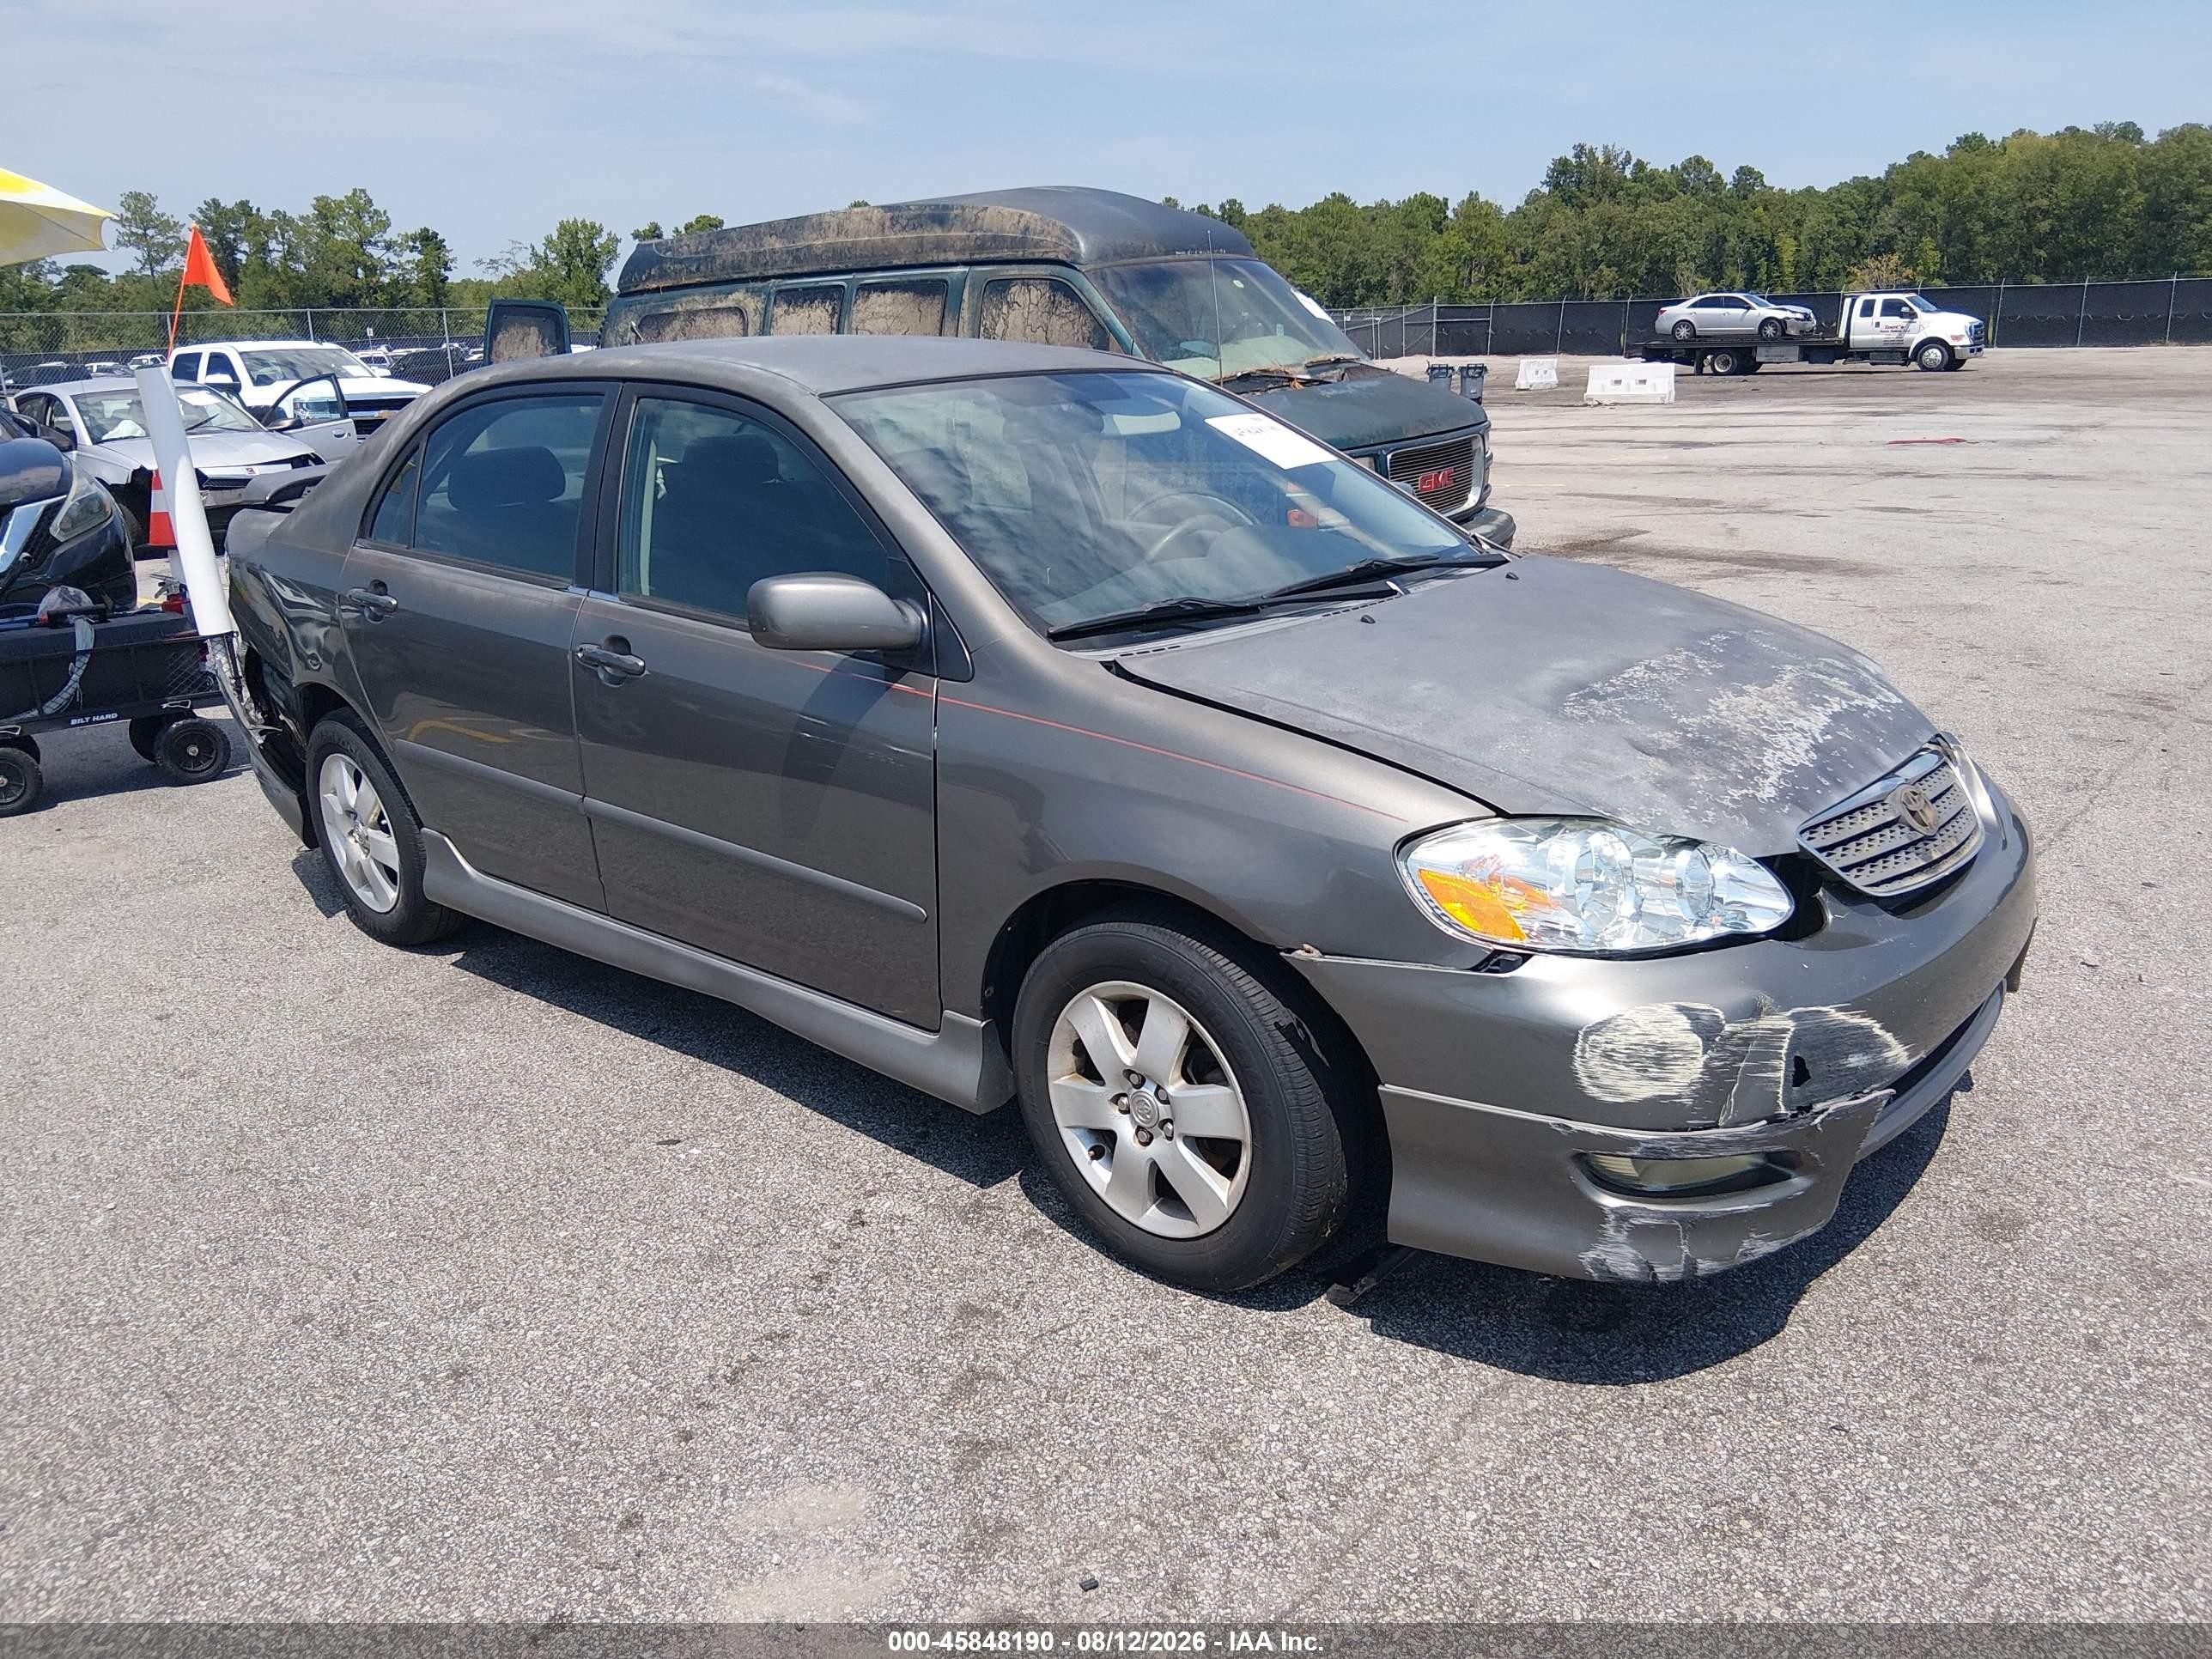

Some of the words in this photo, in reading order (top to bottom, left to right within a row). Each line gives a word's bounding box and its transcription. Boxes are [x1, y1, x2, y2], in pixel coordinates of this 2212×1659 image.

[1419, 467, 1455, 494] GMC
[70, 717, 91, 726] BILT
[92, 713, 118, 722] HARD
